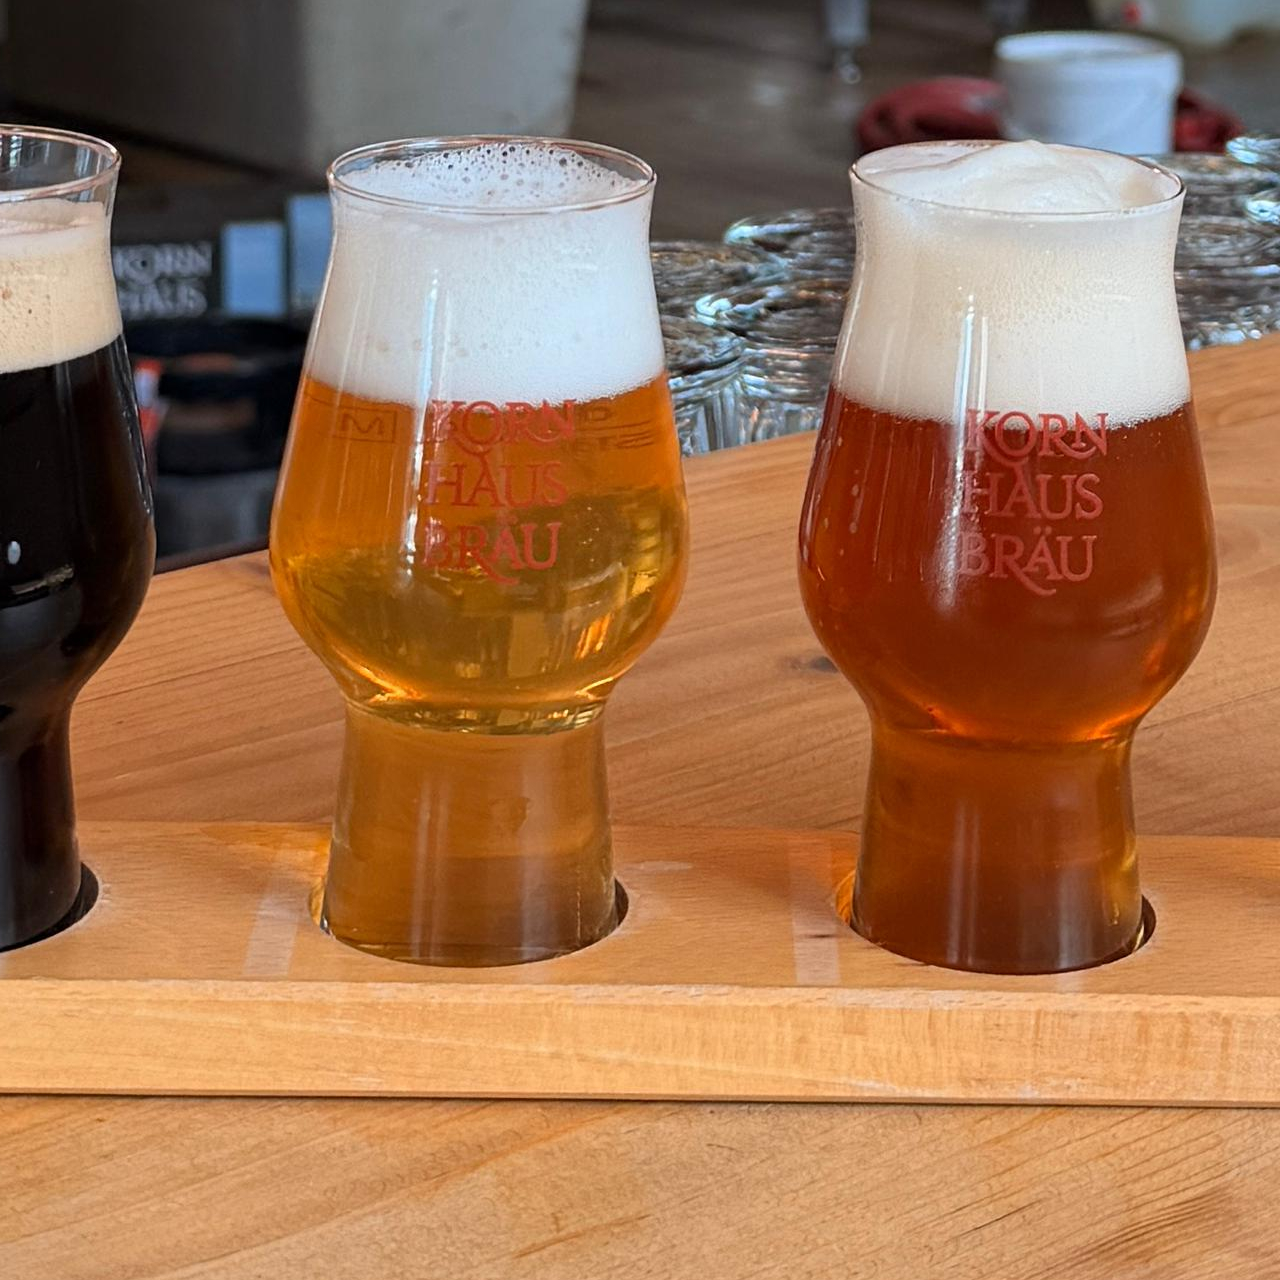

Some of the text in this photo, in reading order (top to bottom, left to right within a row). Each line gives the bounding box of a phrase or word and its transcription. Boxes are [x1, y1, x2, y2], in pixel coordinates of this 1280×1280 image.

[426, 398, 577, 452] KORN
[966, 409, 1109, 467] KORN
[425, 455, 568, 508] HAUS
[962, 462, 1102, 520] HAUS
[422, 517, 561, 585] BRÄU
[958, 527, 1098, 596] BRÄU
